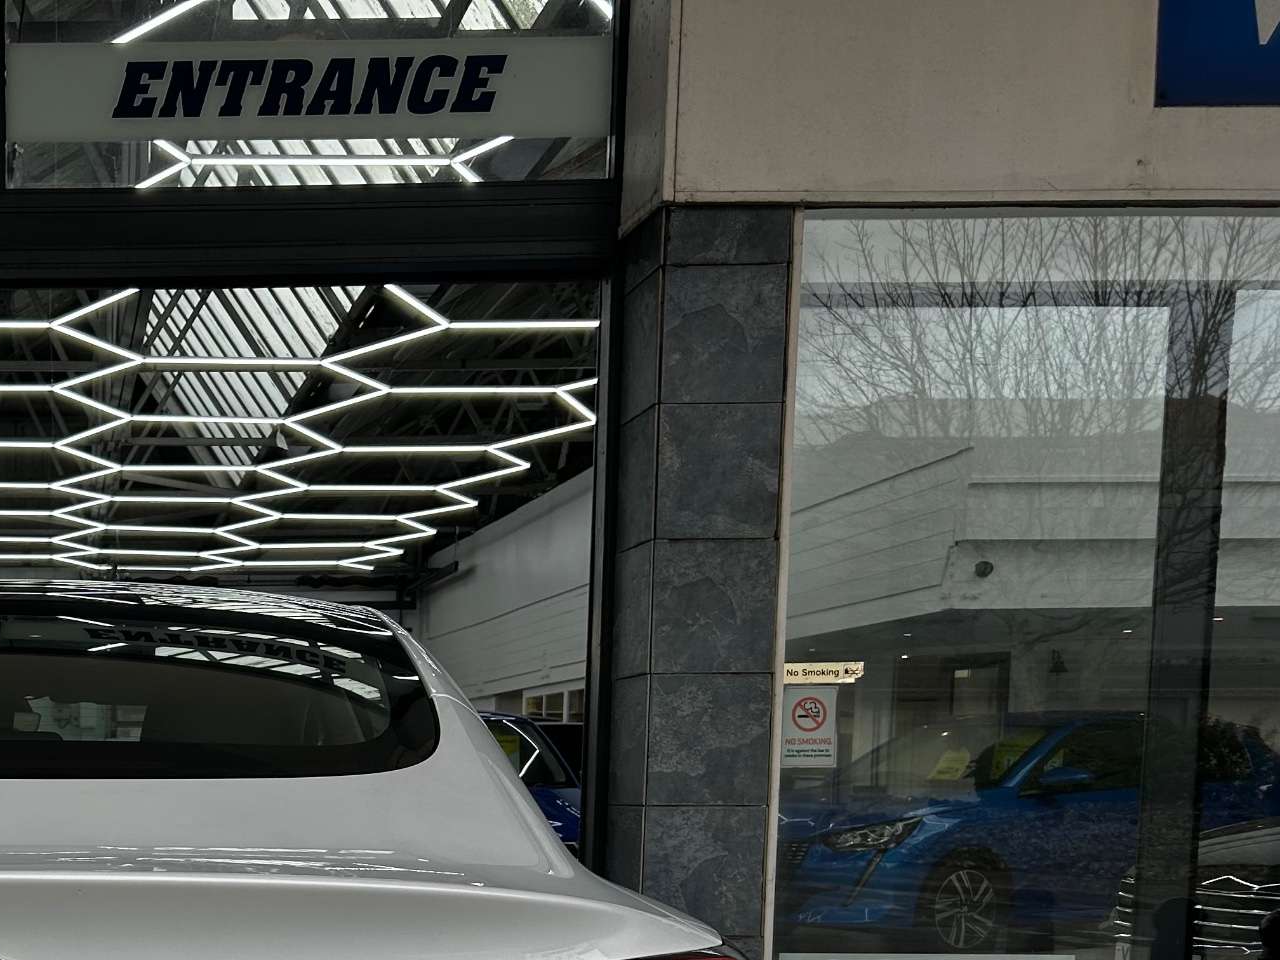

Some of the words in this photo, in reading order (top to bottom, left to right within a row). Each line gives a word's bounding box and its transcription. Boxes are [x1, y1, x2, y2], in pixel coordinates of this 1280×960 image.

[112, 54, 508, 119] ENTRANCE
[786, 669, 799, 677] No
[802, 668, 839, 677] Smoking
[785, 737, 797, 745] NO
[799, 737, 832, 745] SMOKING
